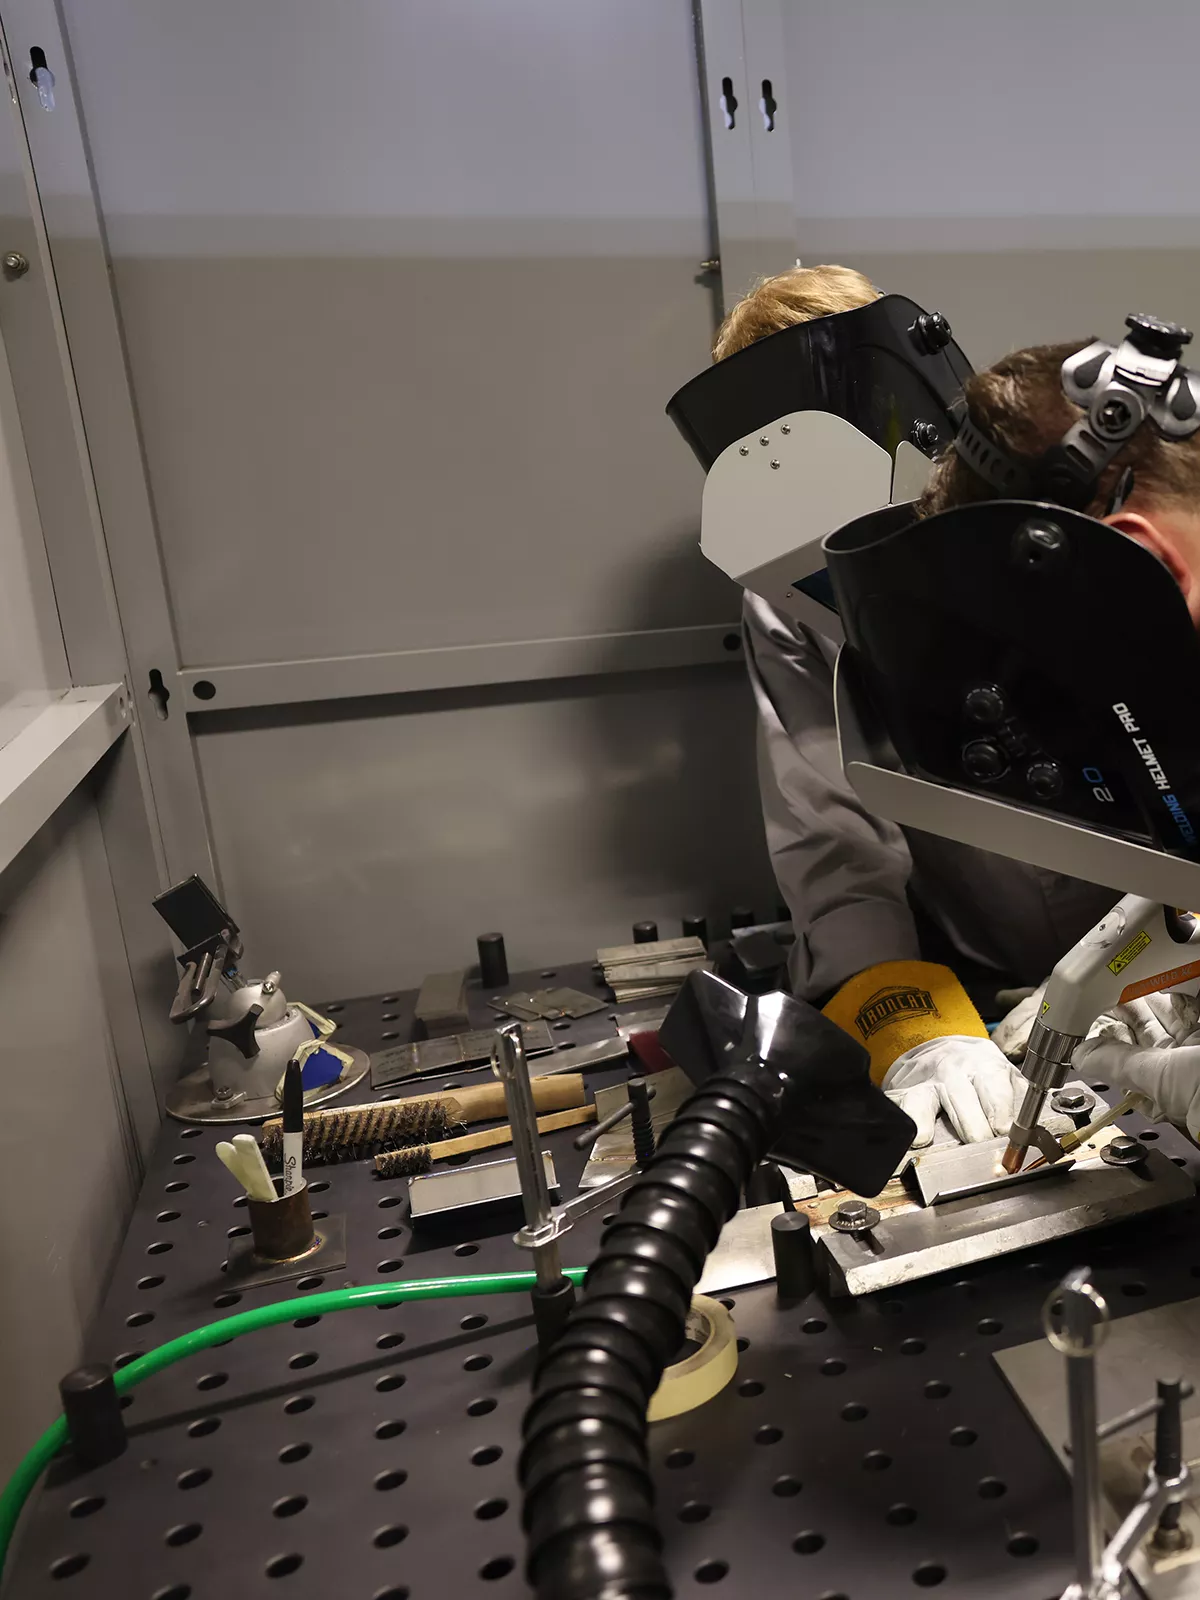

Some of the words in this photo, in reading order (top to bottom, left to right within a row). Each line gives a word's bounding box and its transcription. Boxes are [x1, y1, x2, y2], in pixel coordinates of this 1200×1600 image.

[1112, 702, 1140, 733] PRO
[1132, 738, 1171, 790] HELMET
[1162, 793, 1199, 846] WELDING
[859, 992, 931, 1033] IRONCAT
[284, 1154, 296, 1192] Sharpie
